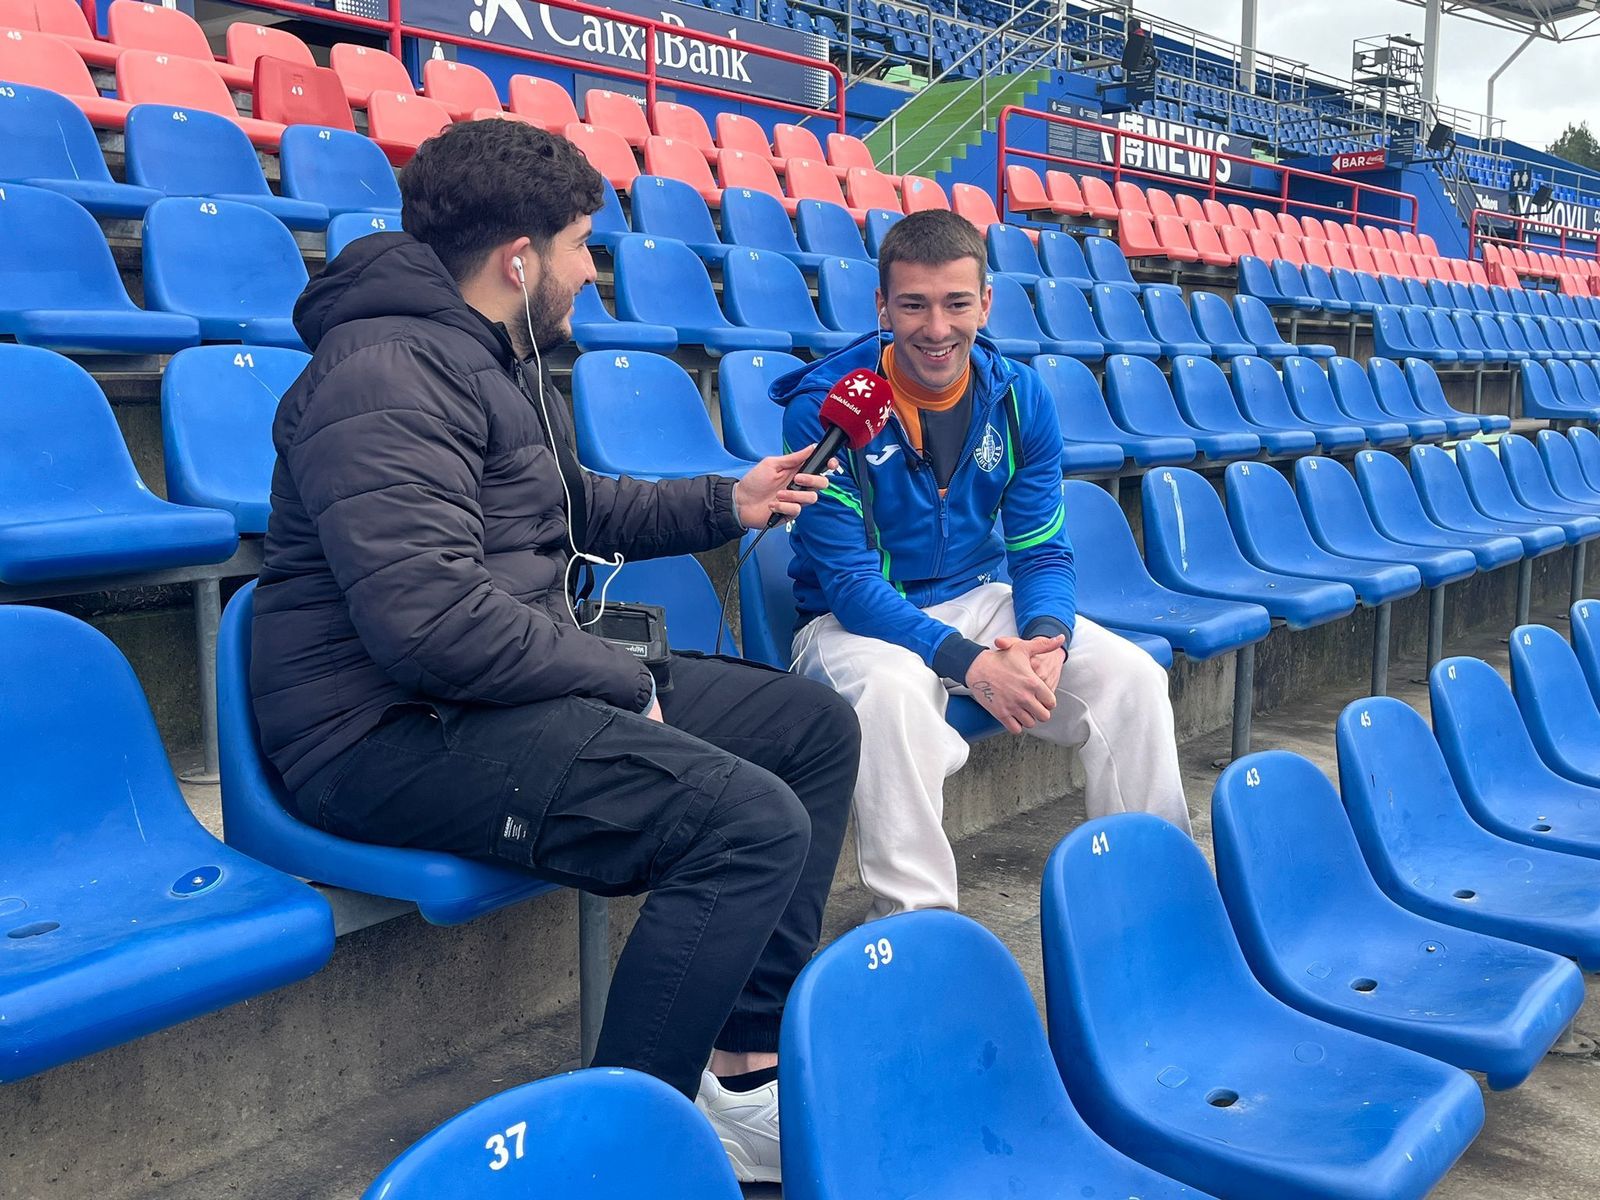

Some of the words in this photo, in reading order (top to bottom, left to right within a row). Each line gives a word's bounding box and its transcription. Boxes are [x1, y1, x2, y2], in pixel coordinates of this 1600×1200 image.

[7, 31, 22, 41] 45
[539, 0, 752, 83] CaixaBank
[156, 56, 168, 65] 47
[291, 86, 303, 97] 49
[172, 111, 188, 122] 45
[318, 130, 331, 140] 47
[1341, 156, 1366, 168] BAR
[742, 189, 751, 198] 55
[199, 203, 218, 215] 43
[371, 218, 386, 229] 45
[644, 239, 655, 249] 49
[750, 252, 759, 261] 51
[233, 354, 254, 368] 41
[615, 357, 629, 369] 45
[752, 357, 763, 367] 47
[830, 393, 862, 415] OndaMadrid
[1241, 464, 1250, 477] 51
[1309, 460, 1318, 471] 53
[1448, 665, 1457, 680] 47
[1360, 711, 1372, 728] 45
[1246, 767, 1261, 787] 43
[1092, 832, 1110, 856] 41
[864, 938, 893, 970] 39
[485, 1121, 527, 1171] 37
